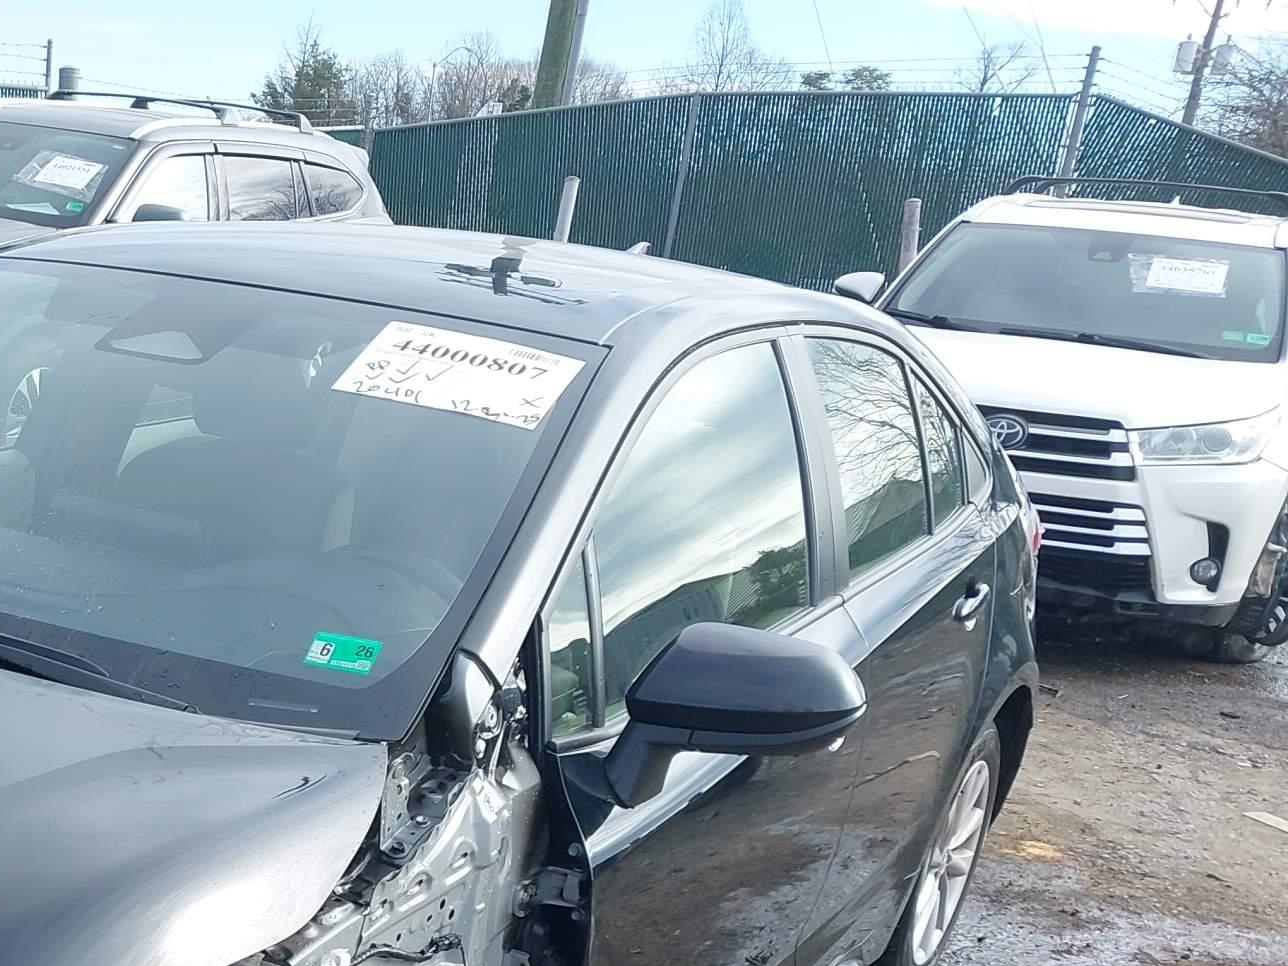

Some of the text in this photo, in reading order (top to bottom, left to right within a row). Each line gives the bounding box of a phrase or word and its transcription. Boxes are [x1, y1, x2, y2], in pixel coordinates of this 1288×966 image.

[393, 340, 550, 379] 44000807
[319, 643, 375, 657] 6 26
